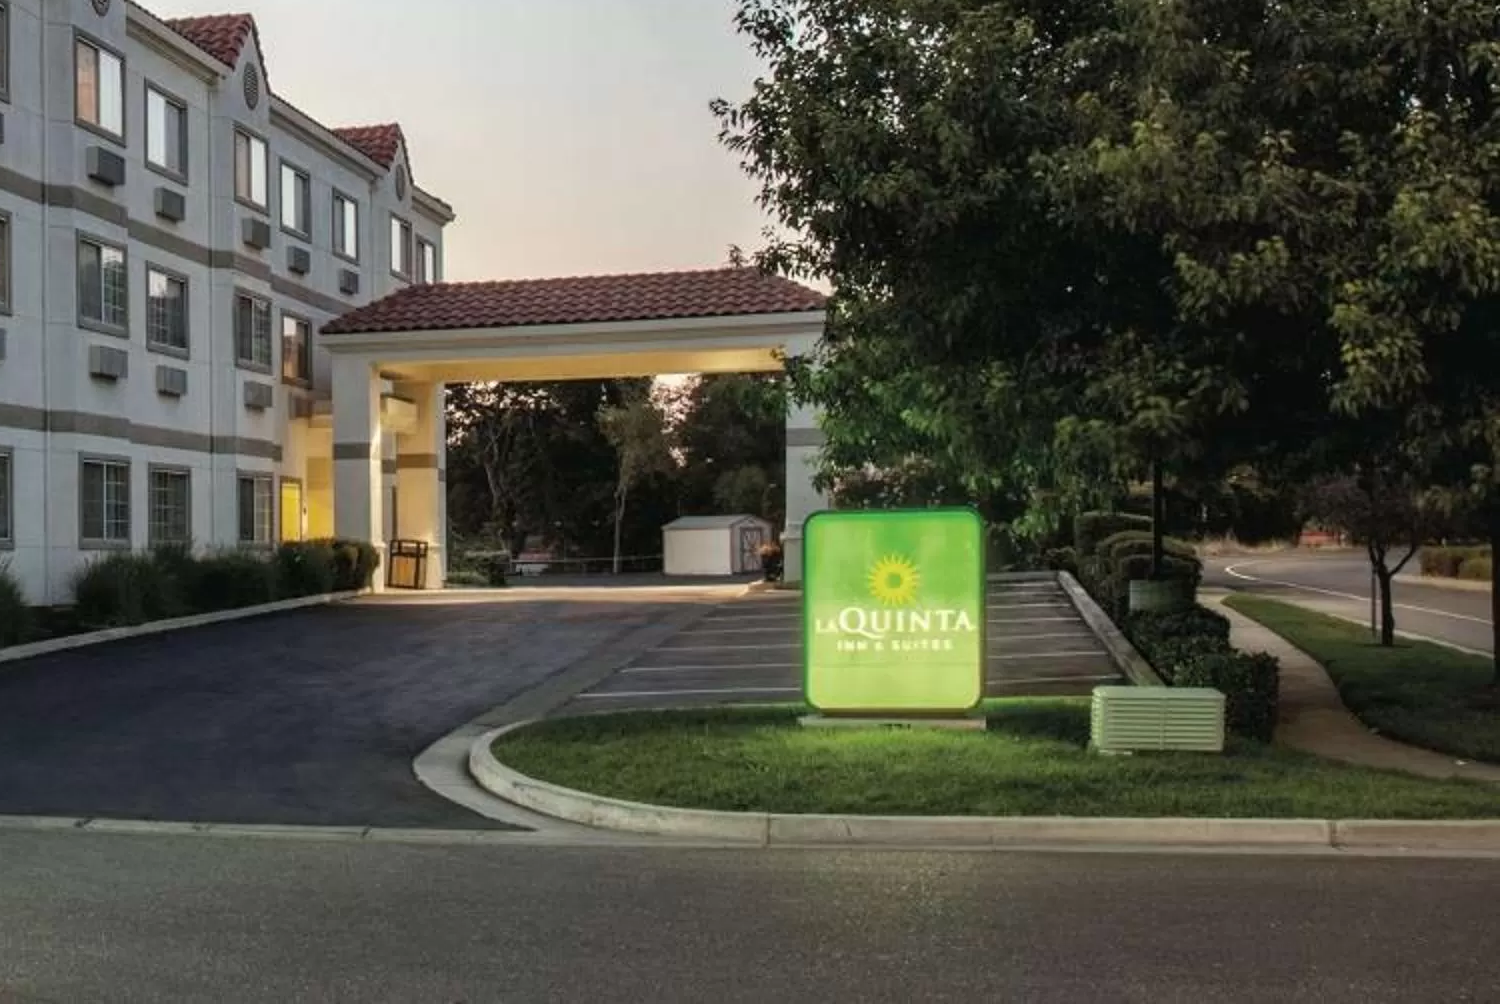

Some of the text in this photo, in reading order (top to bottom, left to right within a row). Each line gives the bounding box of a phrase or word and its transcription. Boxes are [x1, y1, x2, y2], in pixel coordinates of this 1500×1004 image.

[838, 607, 977, 639] QUINTA
[836, 639, 869, 651] INN
[891, 639, 953, 651] SUITES
